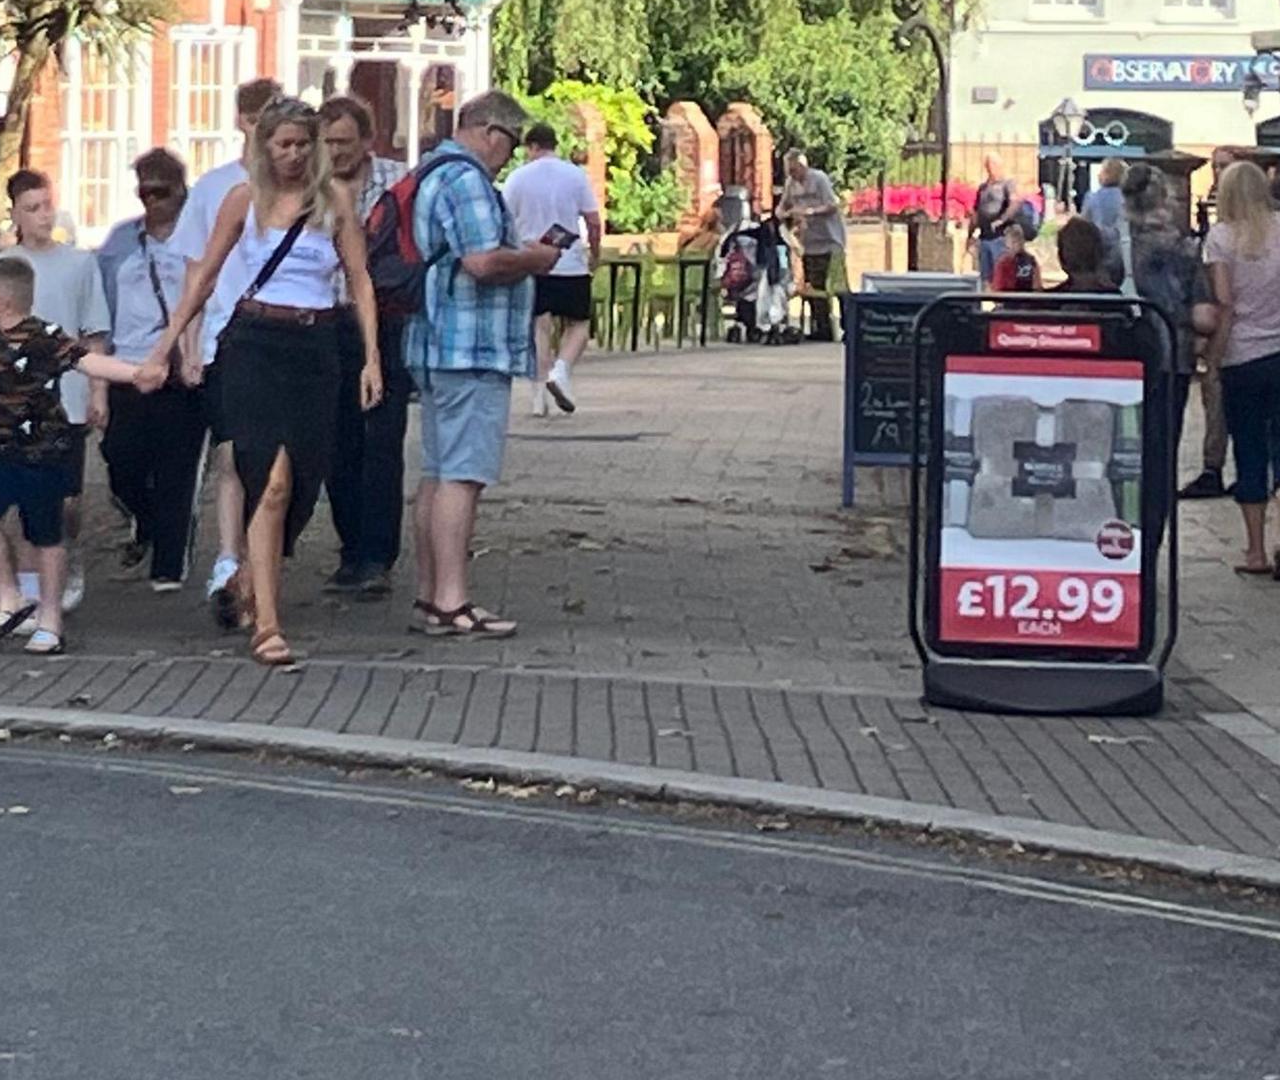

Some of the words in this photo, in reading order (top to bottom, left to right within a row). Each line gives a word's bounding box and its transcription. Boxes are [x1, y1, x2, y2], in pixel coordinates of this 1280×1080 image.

[1091, 57, 1237, 84] OBSERVATORY
[957, 575, 1124, 623] £12.99
[1017, 621, 1062, 635] EACH
